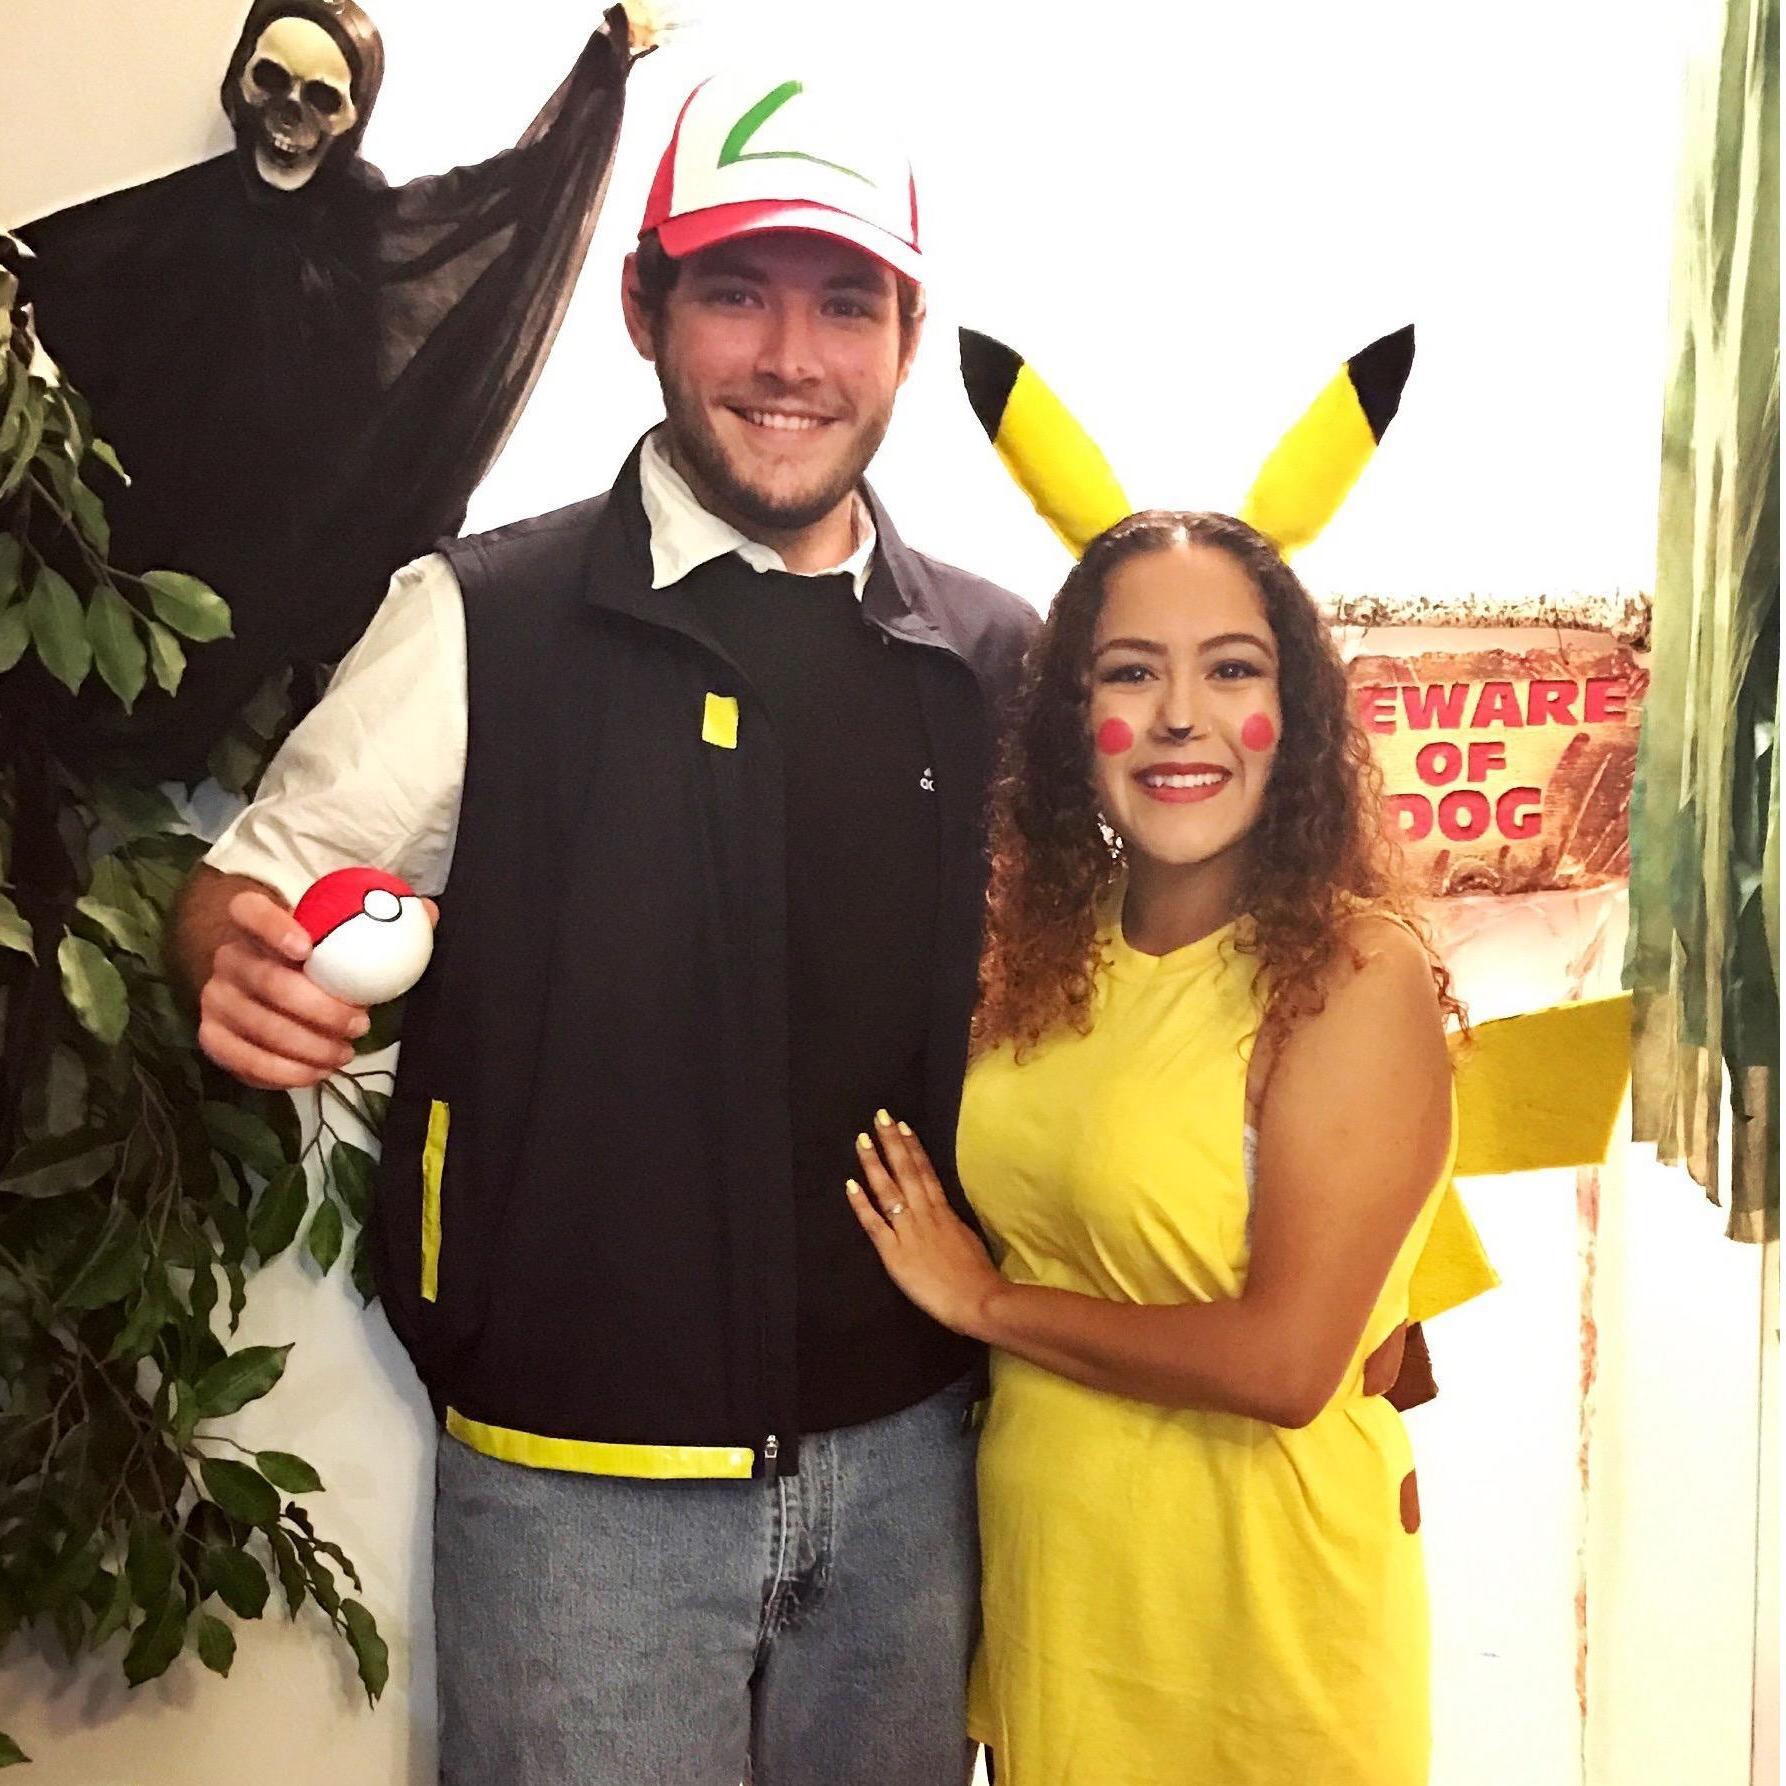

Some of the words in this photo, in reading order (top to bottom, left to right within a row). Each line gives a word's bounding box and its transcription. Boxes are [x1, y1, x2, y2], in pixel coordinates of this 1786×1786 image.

[1355, 677, 1628, 735] EWARE
[1415, 741, 1507, 787] OF
[1382, 786, 1543, 842] DOG
